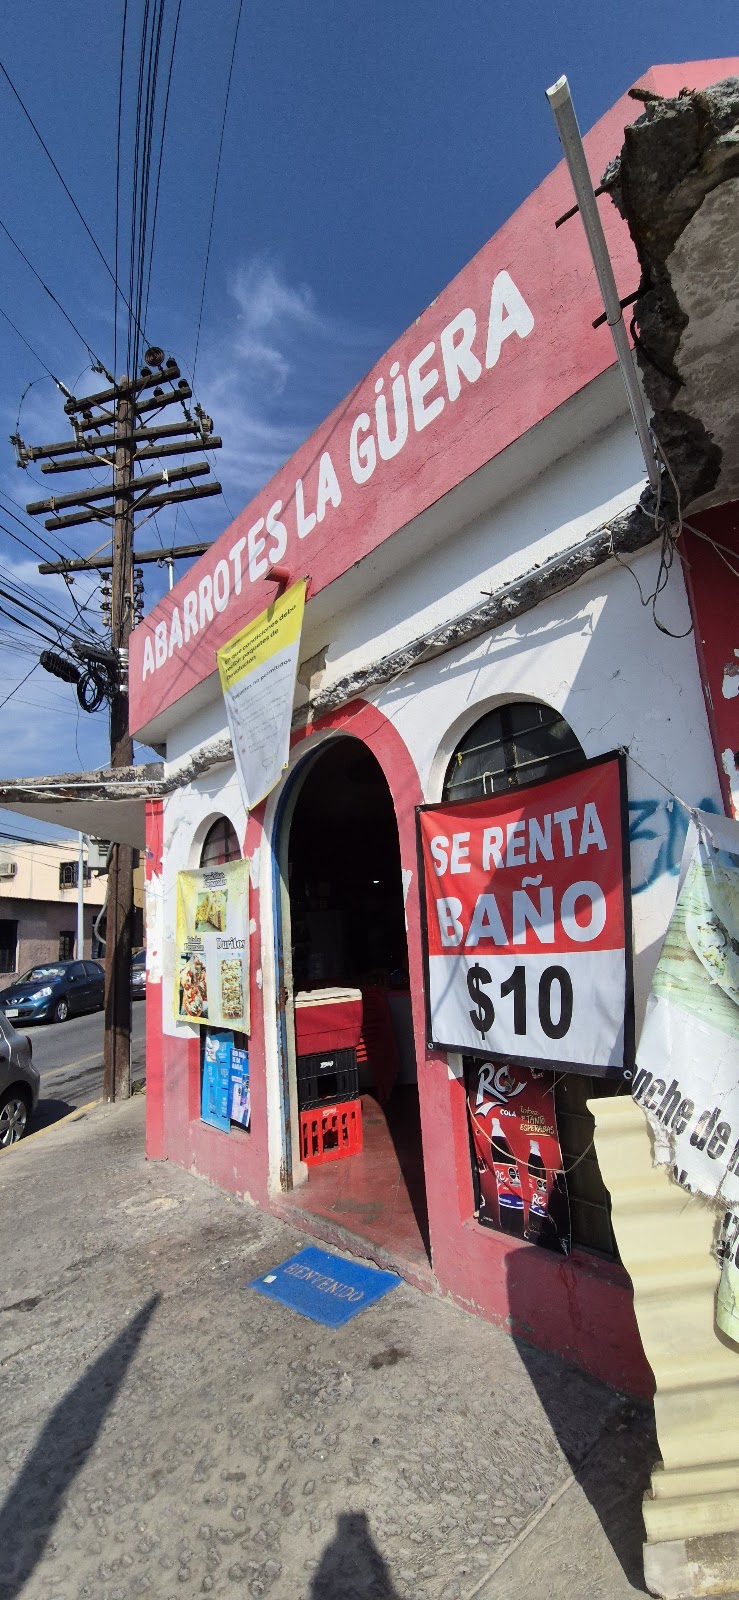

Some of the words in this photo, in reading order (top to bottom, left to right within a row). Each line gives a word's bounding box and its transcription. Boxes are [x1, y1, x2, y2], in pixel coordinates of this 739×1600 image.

[141, 499, 288, 682] ABARROTES
[295, 451, 343, 539] LA
[348, 269, 535, 485] GÜERA
[231, 648, 243, 661] que
[242, 619, 279, 651] condiciones
[242, 635, 270, 661] paquetes
[270, 628, 280, 638] de
[430, 831, 472, 877] SE
[482, 802, 608, 872] RENTA
[436, 873, 607, 948] BAÑO
[466, 962, 574, 1041] $10
[499, 1108, 517, 1118] COLA
[519, 1123, 555, 1135] ESPERABAS
[689, 1106, 732, 1159] de
